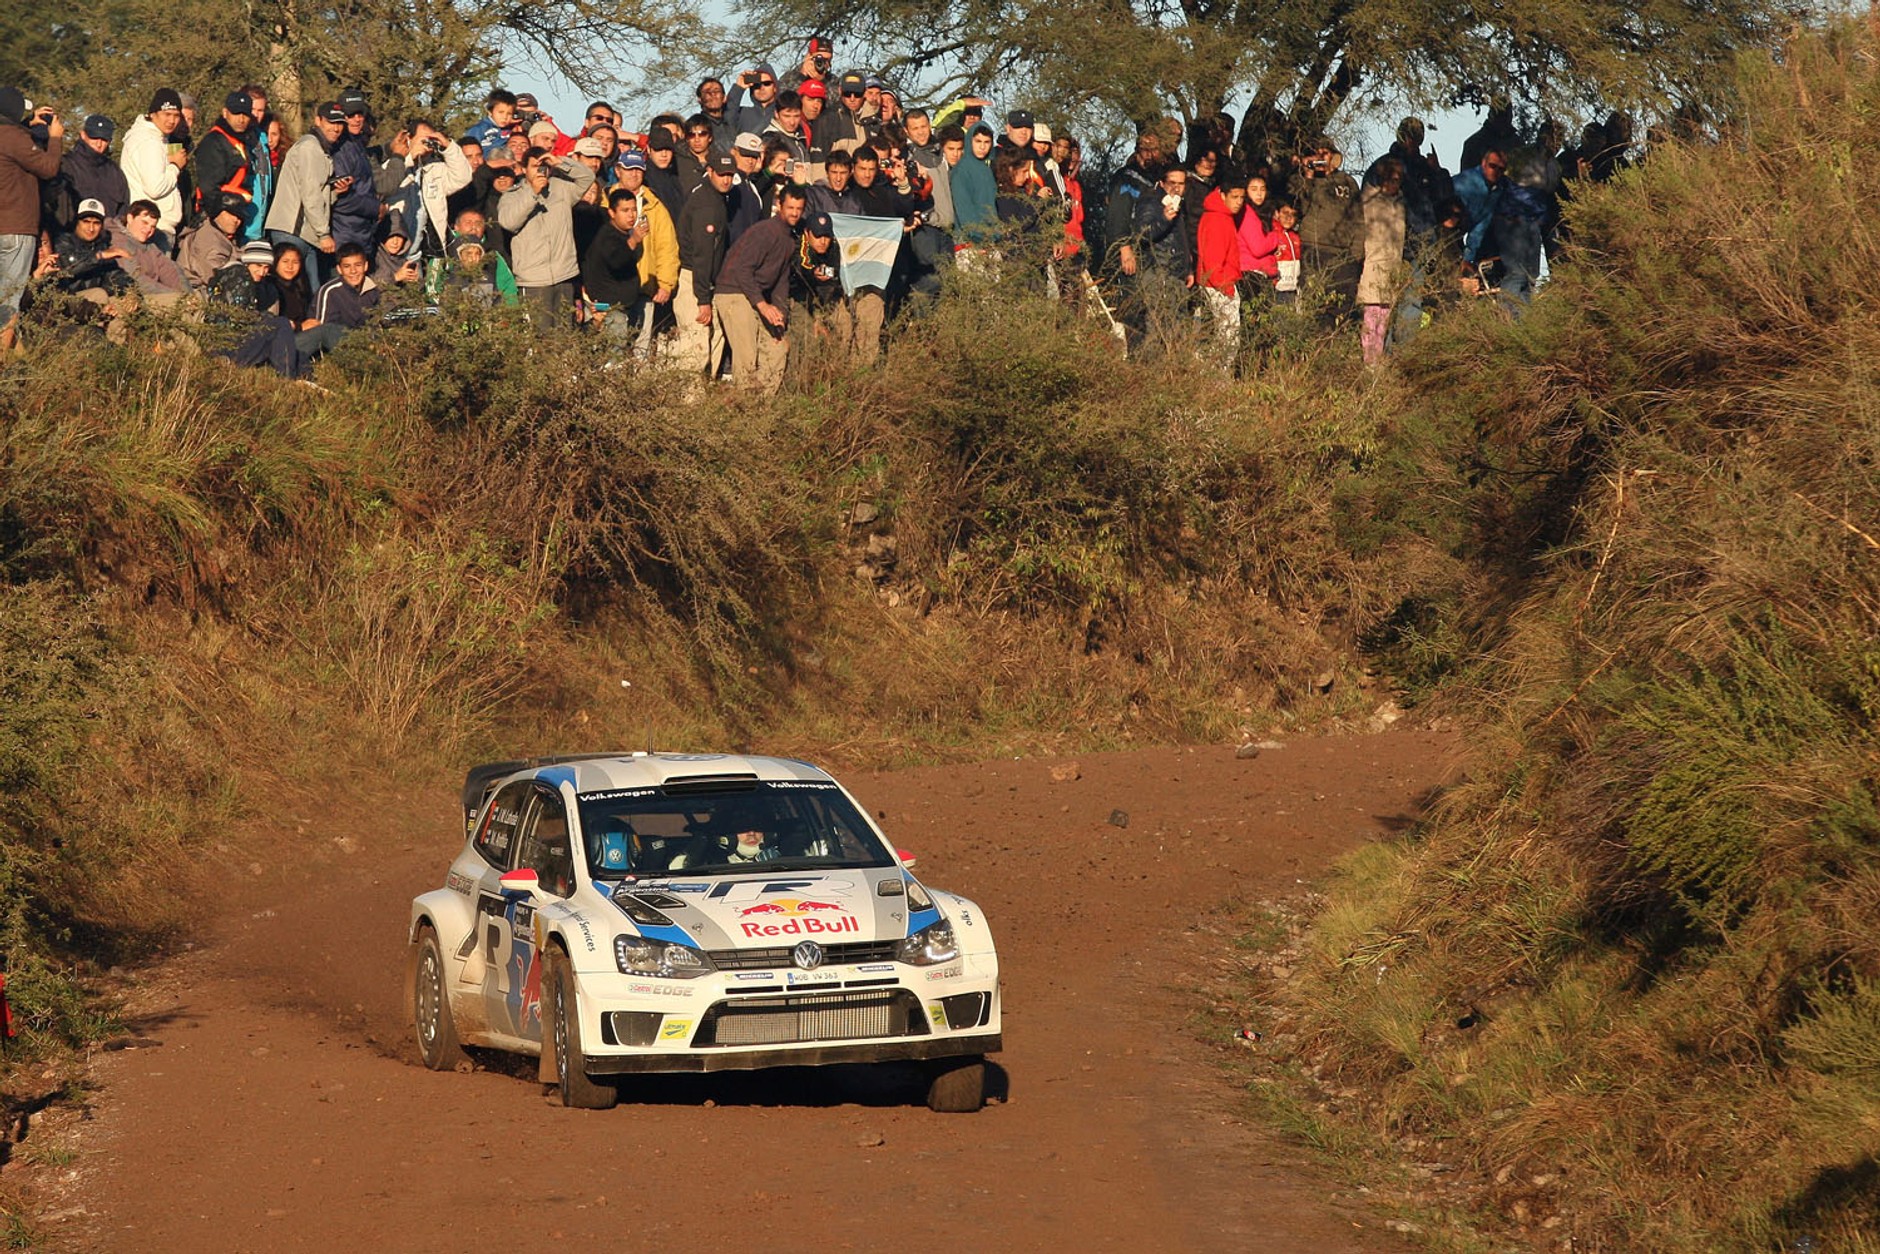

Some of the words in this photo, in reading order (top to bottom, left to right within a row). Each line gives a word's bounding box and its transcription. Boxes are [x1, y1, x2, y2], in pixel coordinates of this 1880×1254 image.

[766, 780, 837, 791] Volkswagen
[579, 788, 656, 802] Volkswagen
[740, 918, 801, 938] Red
[802, 916, 860, 934] Bull
[579, 920, 596, 952] Services
[653, 984, 695, 997] EDGE
